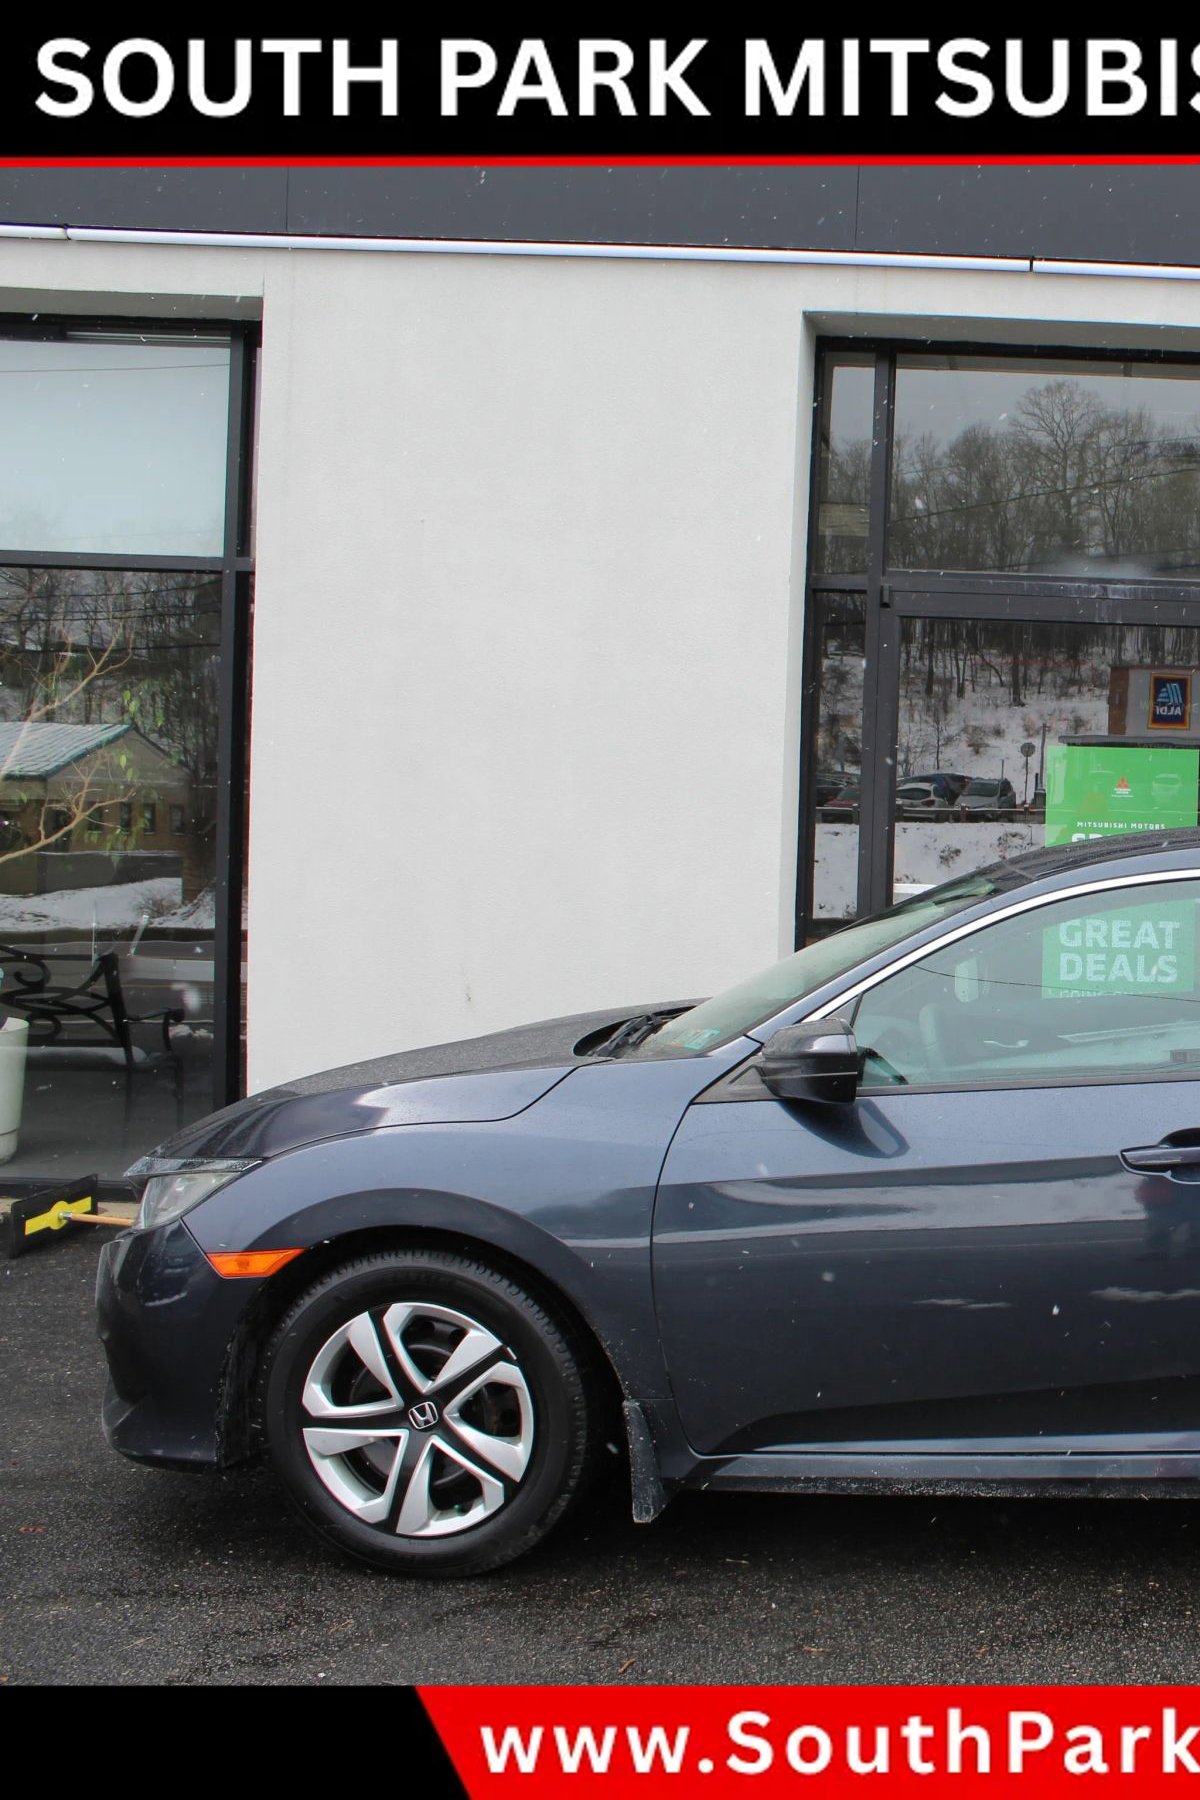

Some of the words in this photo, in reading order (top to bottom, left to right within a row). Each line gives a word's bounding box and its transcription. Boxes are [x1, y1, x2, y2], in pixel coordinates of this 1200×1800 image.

[1076, 820, 1127, 830] MITSUBISHI
[1130, 822, 1166, 831] MOTORS
[1059, 918, 1181, 949] GREAT
[1059, 951, 1178, 984] DEALS
